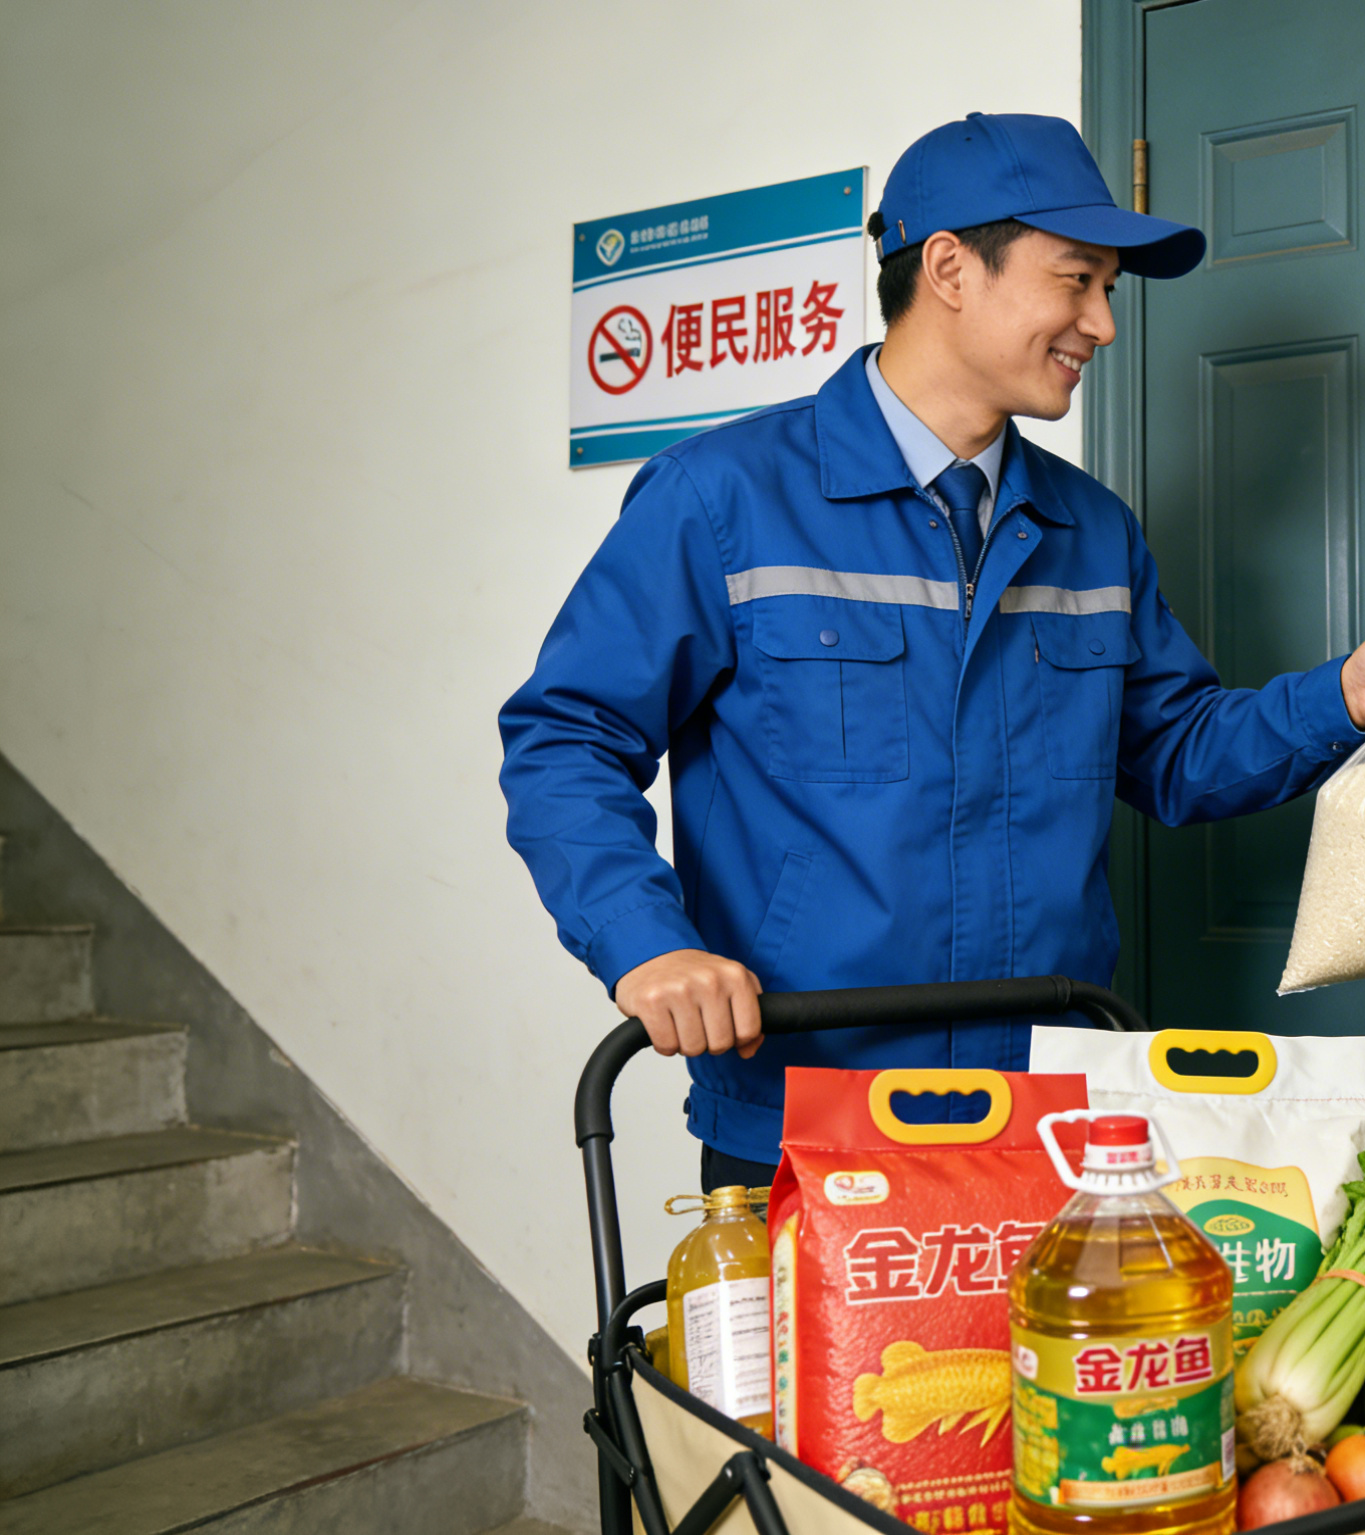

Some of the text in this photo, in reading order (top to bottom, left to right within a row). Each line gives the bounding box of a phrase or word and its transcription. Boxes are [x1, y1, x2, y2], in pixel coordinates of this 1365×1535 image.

[661, 280, 845, 378] 便民服务
[1074, 1334, 1214, 1394] 金龙鱼
